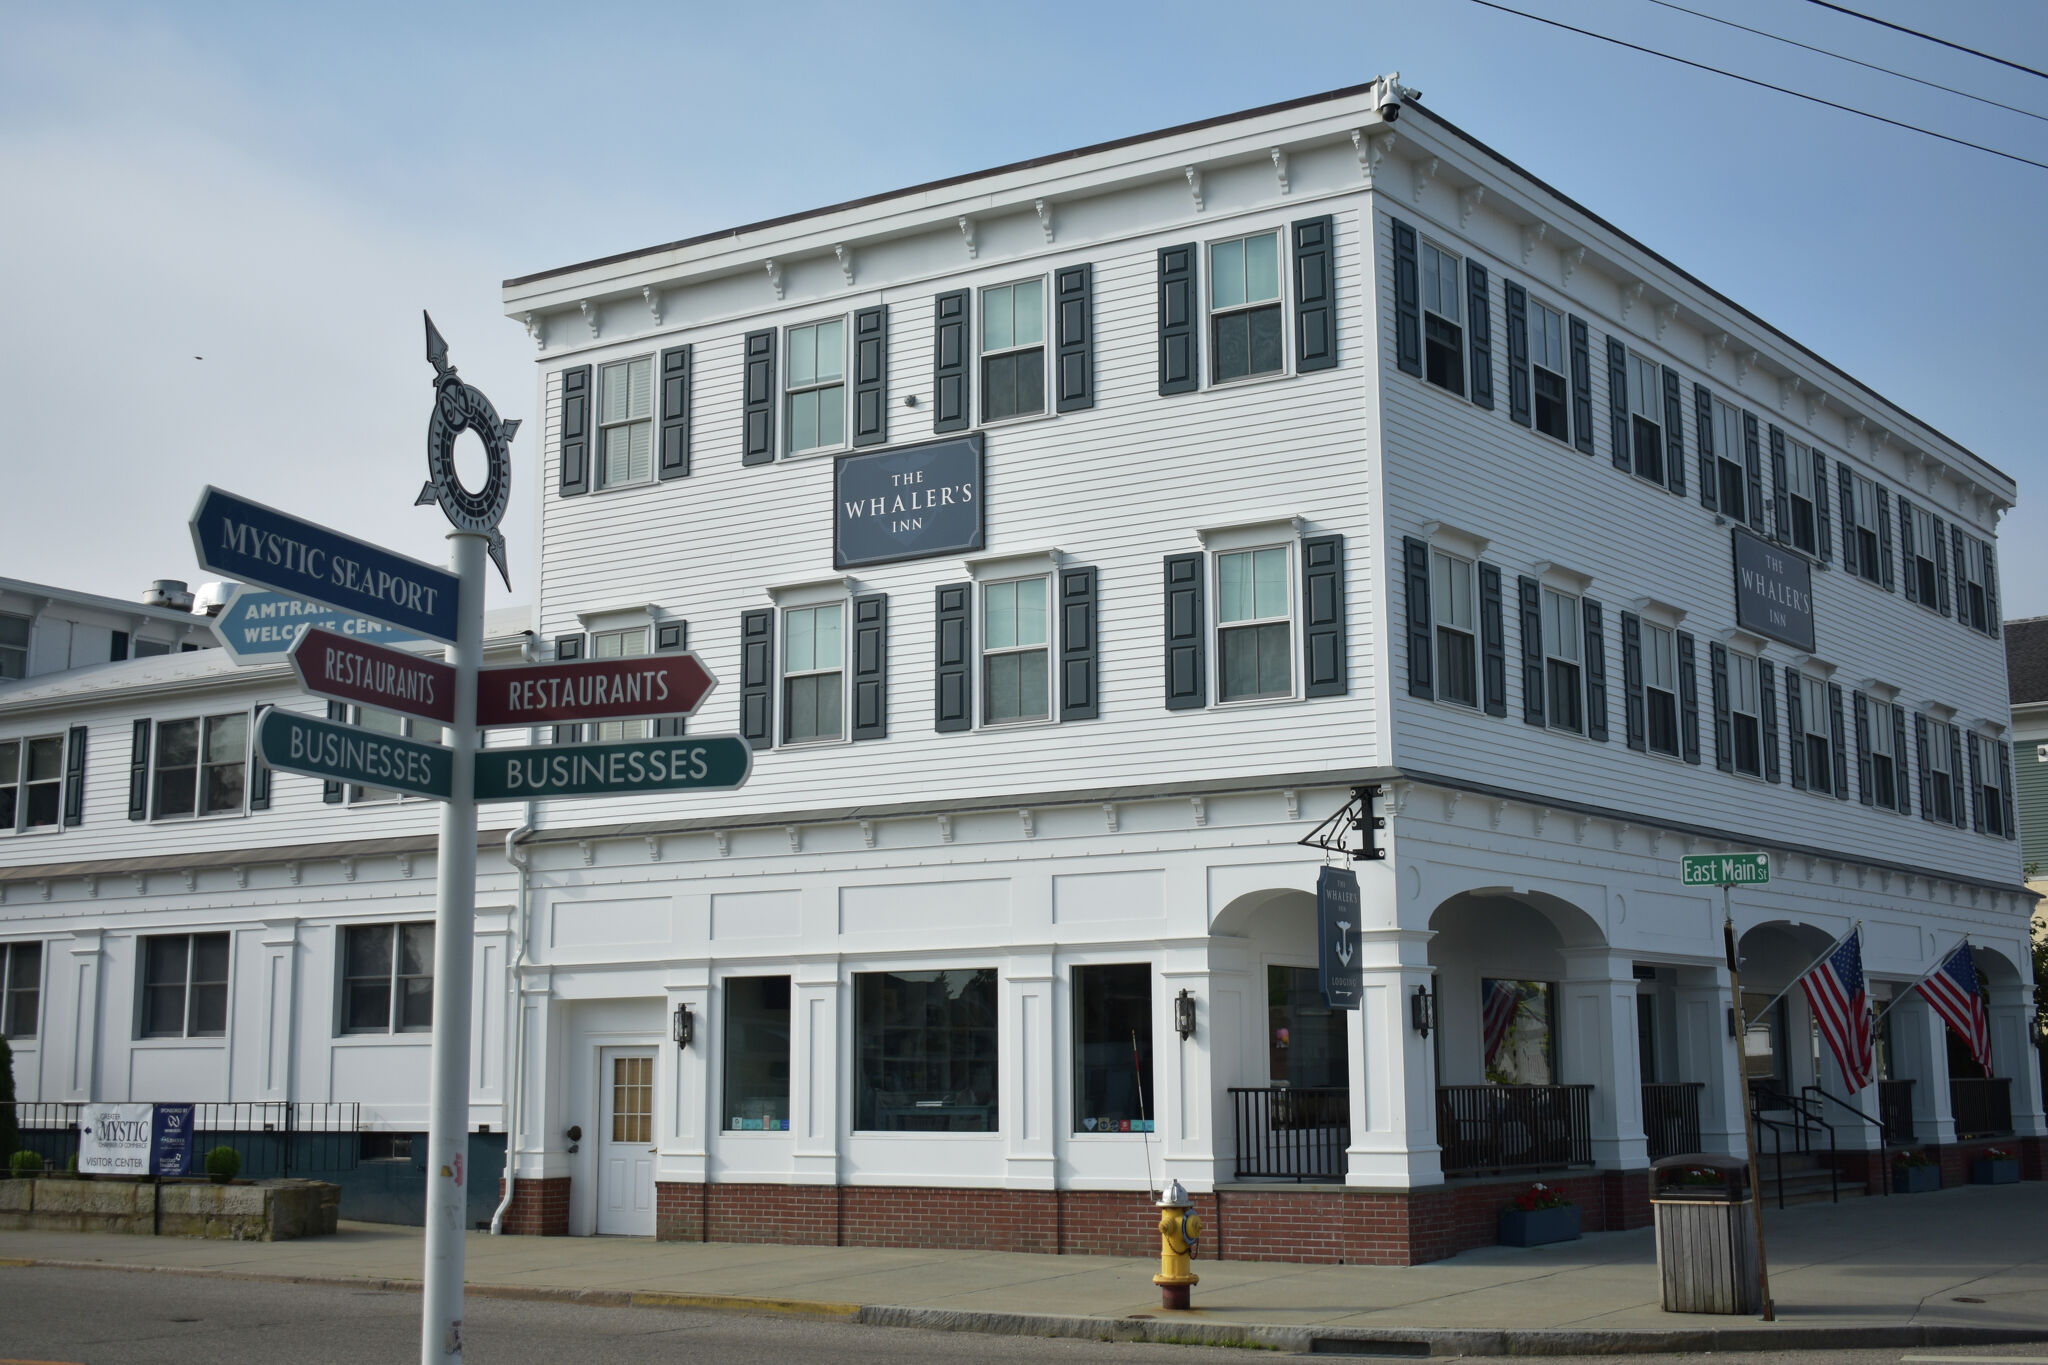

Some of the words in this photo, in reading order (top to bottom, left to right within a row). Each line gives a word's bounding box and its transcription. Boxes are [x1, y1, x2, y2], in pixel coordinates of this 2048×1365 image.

[891, 470, 924, 487] THE
[844, 483, 973, 520] WHALER'S
[892, 517, 923, 533] INN
[221, 517, 325, 579] MYSTIC
[331, 555, 438, 616] SEAPORT
[1765, 554, 1784, 575] THE
[1741, 567, 1810, 615] WHALER'S
[1769, 609, 1787, 628] INN
[325, 647, 435, 705] RESTAURANTS
[508, 670, 669, 711] RESTAURANTS
[291, 725, 432, 785] BUSINESSES
[507, 747, 709, 789] BUSINESSES
[1683, 860, 1718, 882] East
[1722, 858, 1756, 881] Main
[1757, 867, 1768, 881] St
[98, 1120, 148, 1142] MYSTIC
[86, 1157, 113, 1167] VISITOR
[114, 1158, 143, 1168] CENTER
